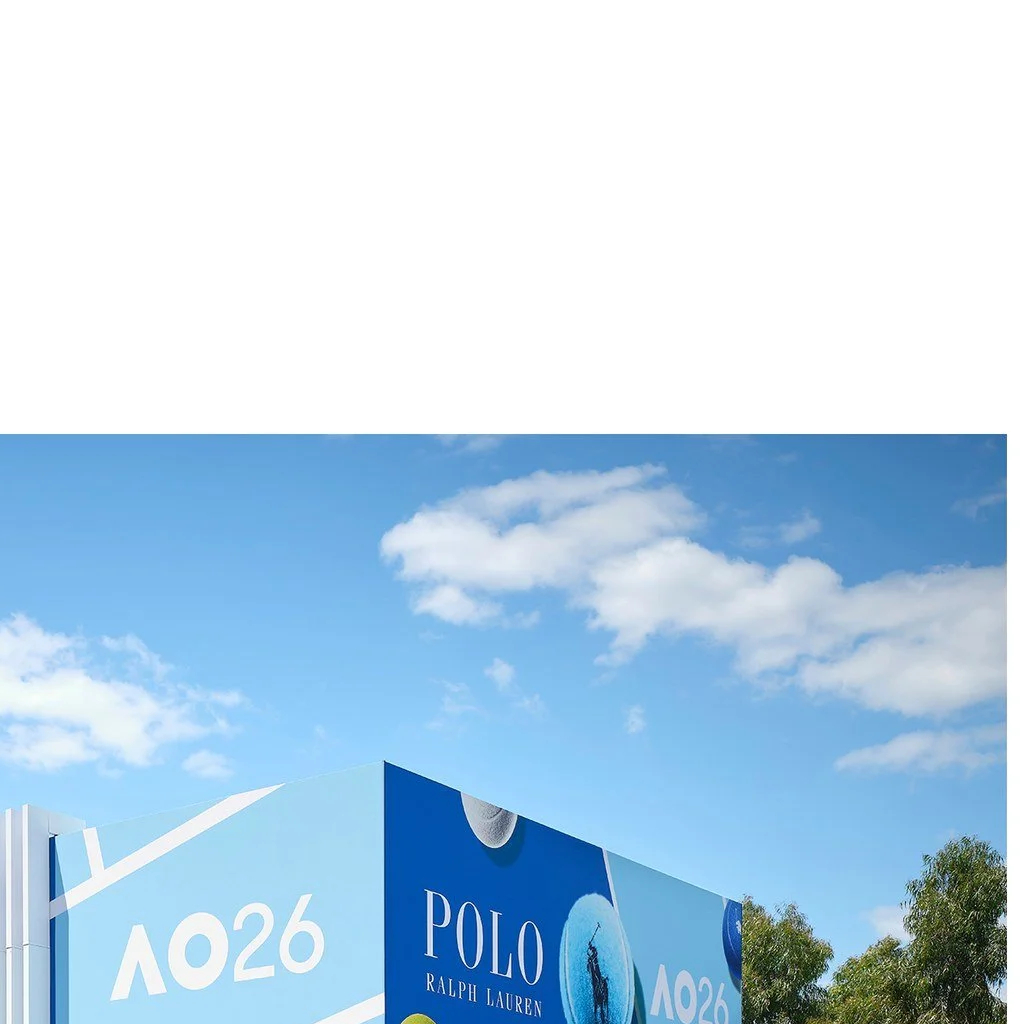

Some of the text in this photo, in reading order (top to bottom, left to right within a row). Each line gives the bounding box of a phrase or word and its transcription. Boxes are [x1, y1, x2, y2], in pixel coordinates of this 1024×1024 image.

[110, 893, 325, 1001] AO26
[424, 888, 544, 986] POLO
[426, 972, 542, 1018] RALPH LAUREN
